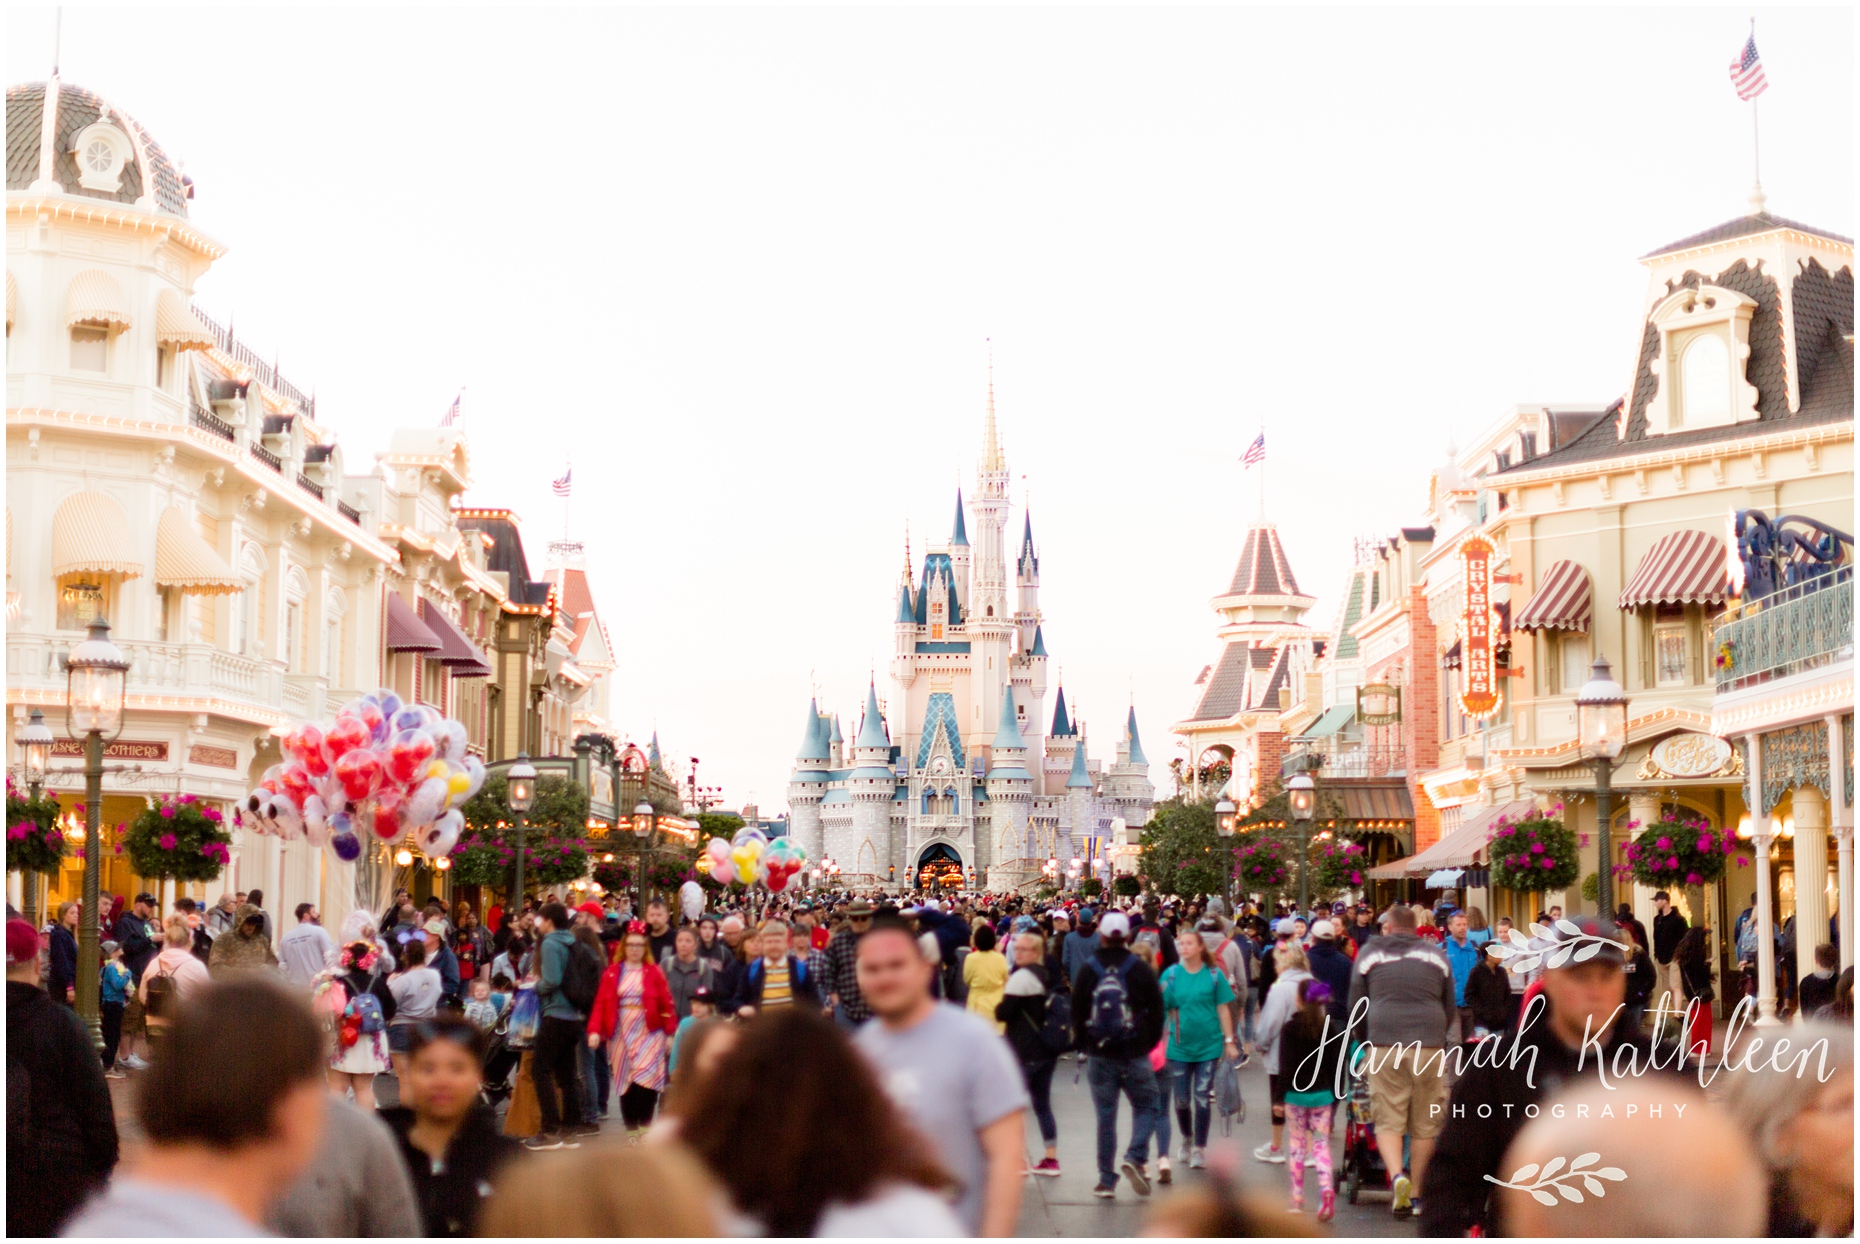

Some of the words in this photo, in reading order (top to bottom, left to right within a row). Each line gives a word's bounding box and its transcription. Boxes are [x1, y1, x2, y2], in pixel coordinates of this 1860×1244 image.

[1469, 559, 1487, 637] CRYSTAL
[1471, 648, 1487, 693] ARTS
[1364, 715, 1393, 725] COFFEE
[100, 742, 159, 758] LOTHIERS
[586, 828, 609, 840] AGIC
